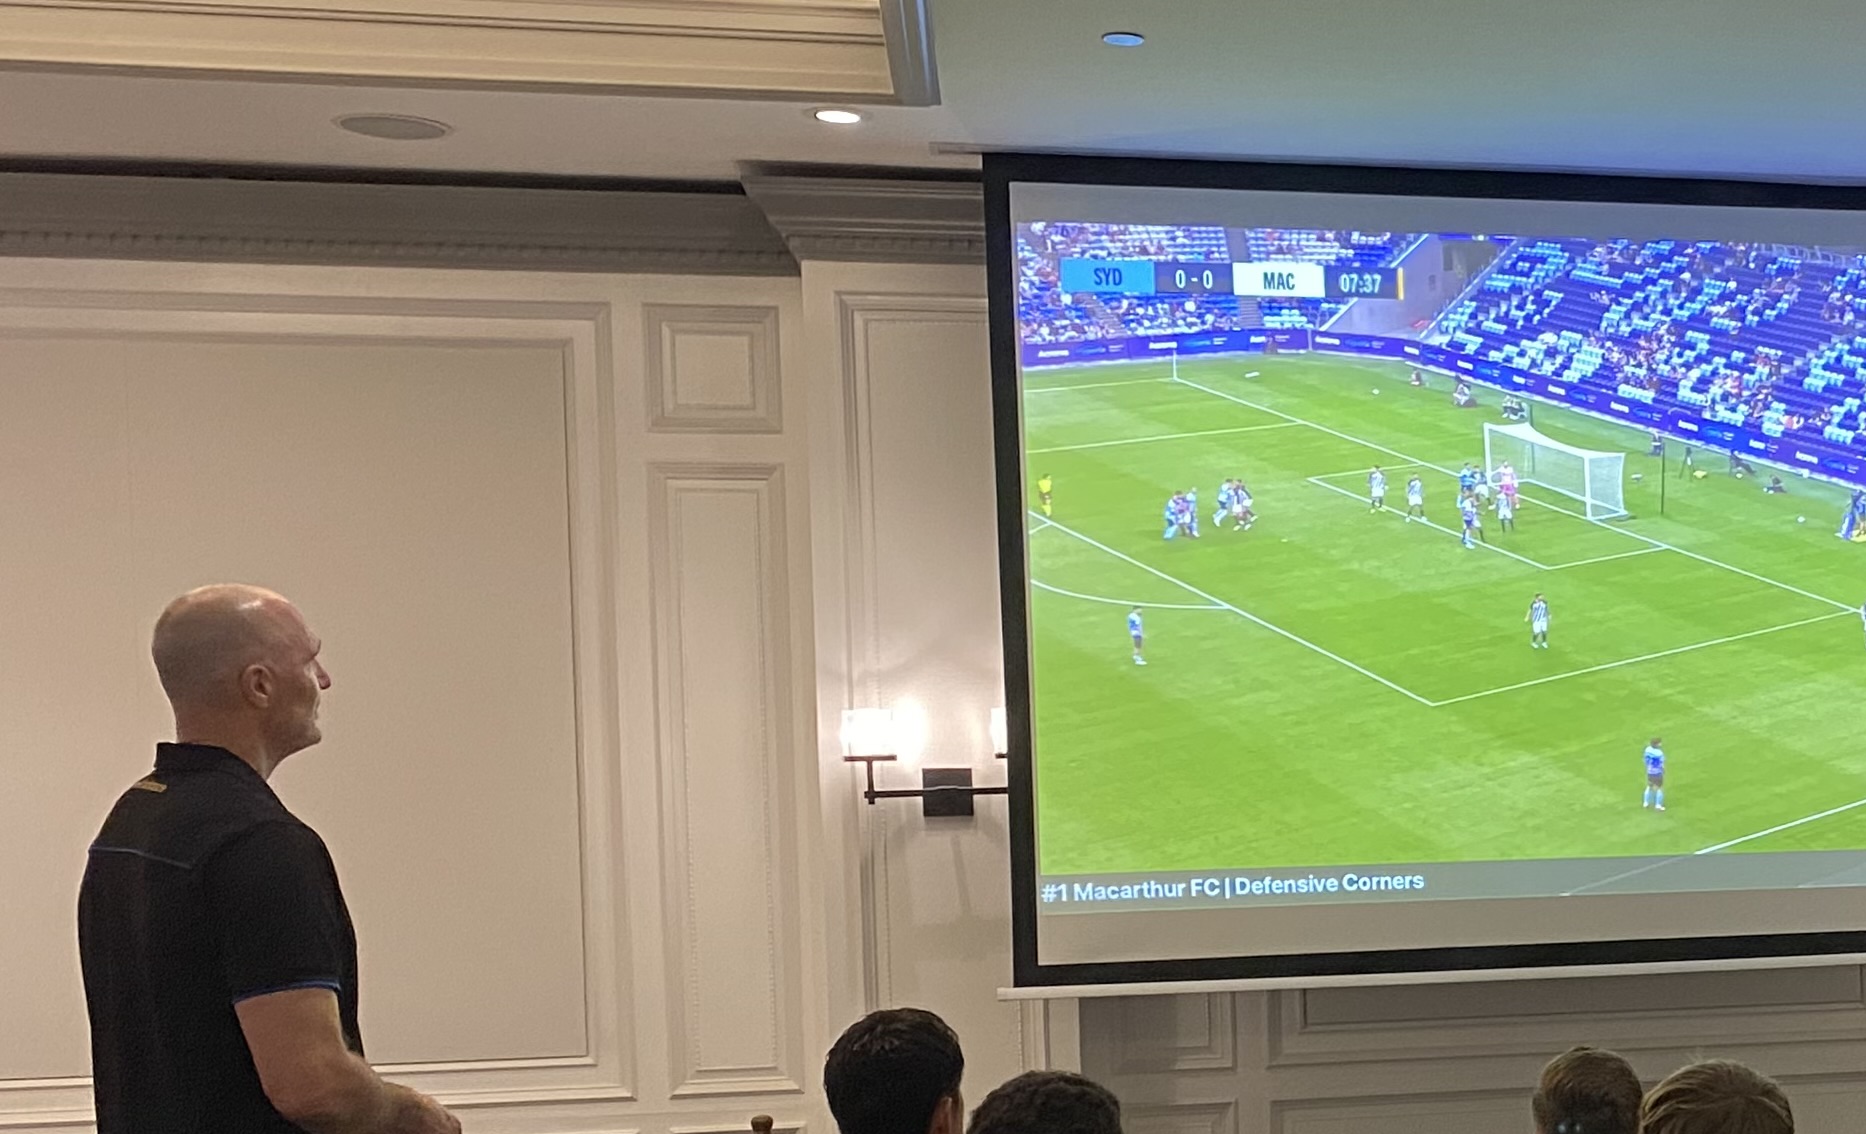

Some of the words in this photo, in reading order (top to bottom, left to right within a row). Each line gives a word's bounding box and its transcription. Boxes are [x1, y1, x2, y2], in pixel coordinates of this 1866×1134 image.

[1093, 267, 1123, 287] SYD
[1175, 270, 1186, 289] 0
[1201, 271, 1213, 290] 0
[1263, 273, 1296, 292] MAC
[1339, 275, 1382, 294] 07:37
[1041, 884, 1068, 903] #1
[1074, 880, 1186, 902] Macarthur
[1190, 878, 1220, 897] FC
[1235, 874, 1339, 896] Defensive
[1342, 872, 1425, 891] Corners
